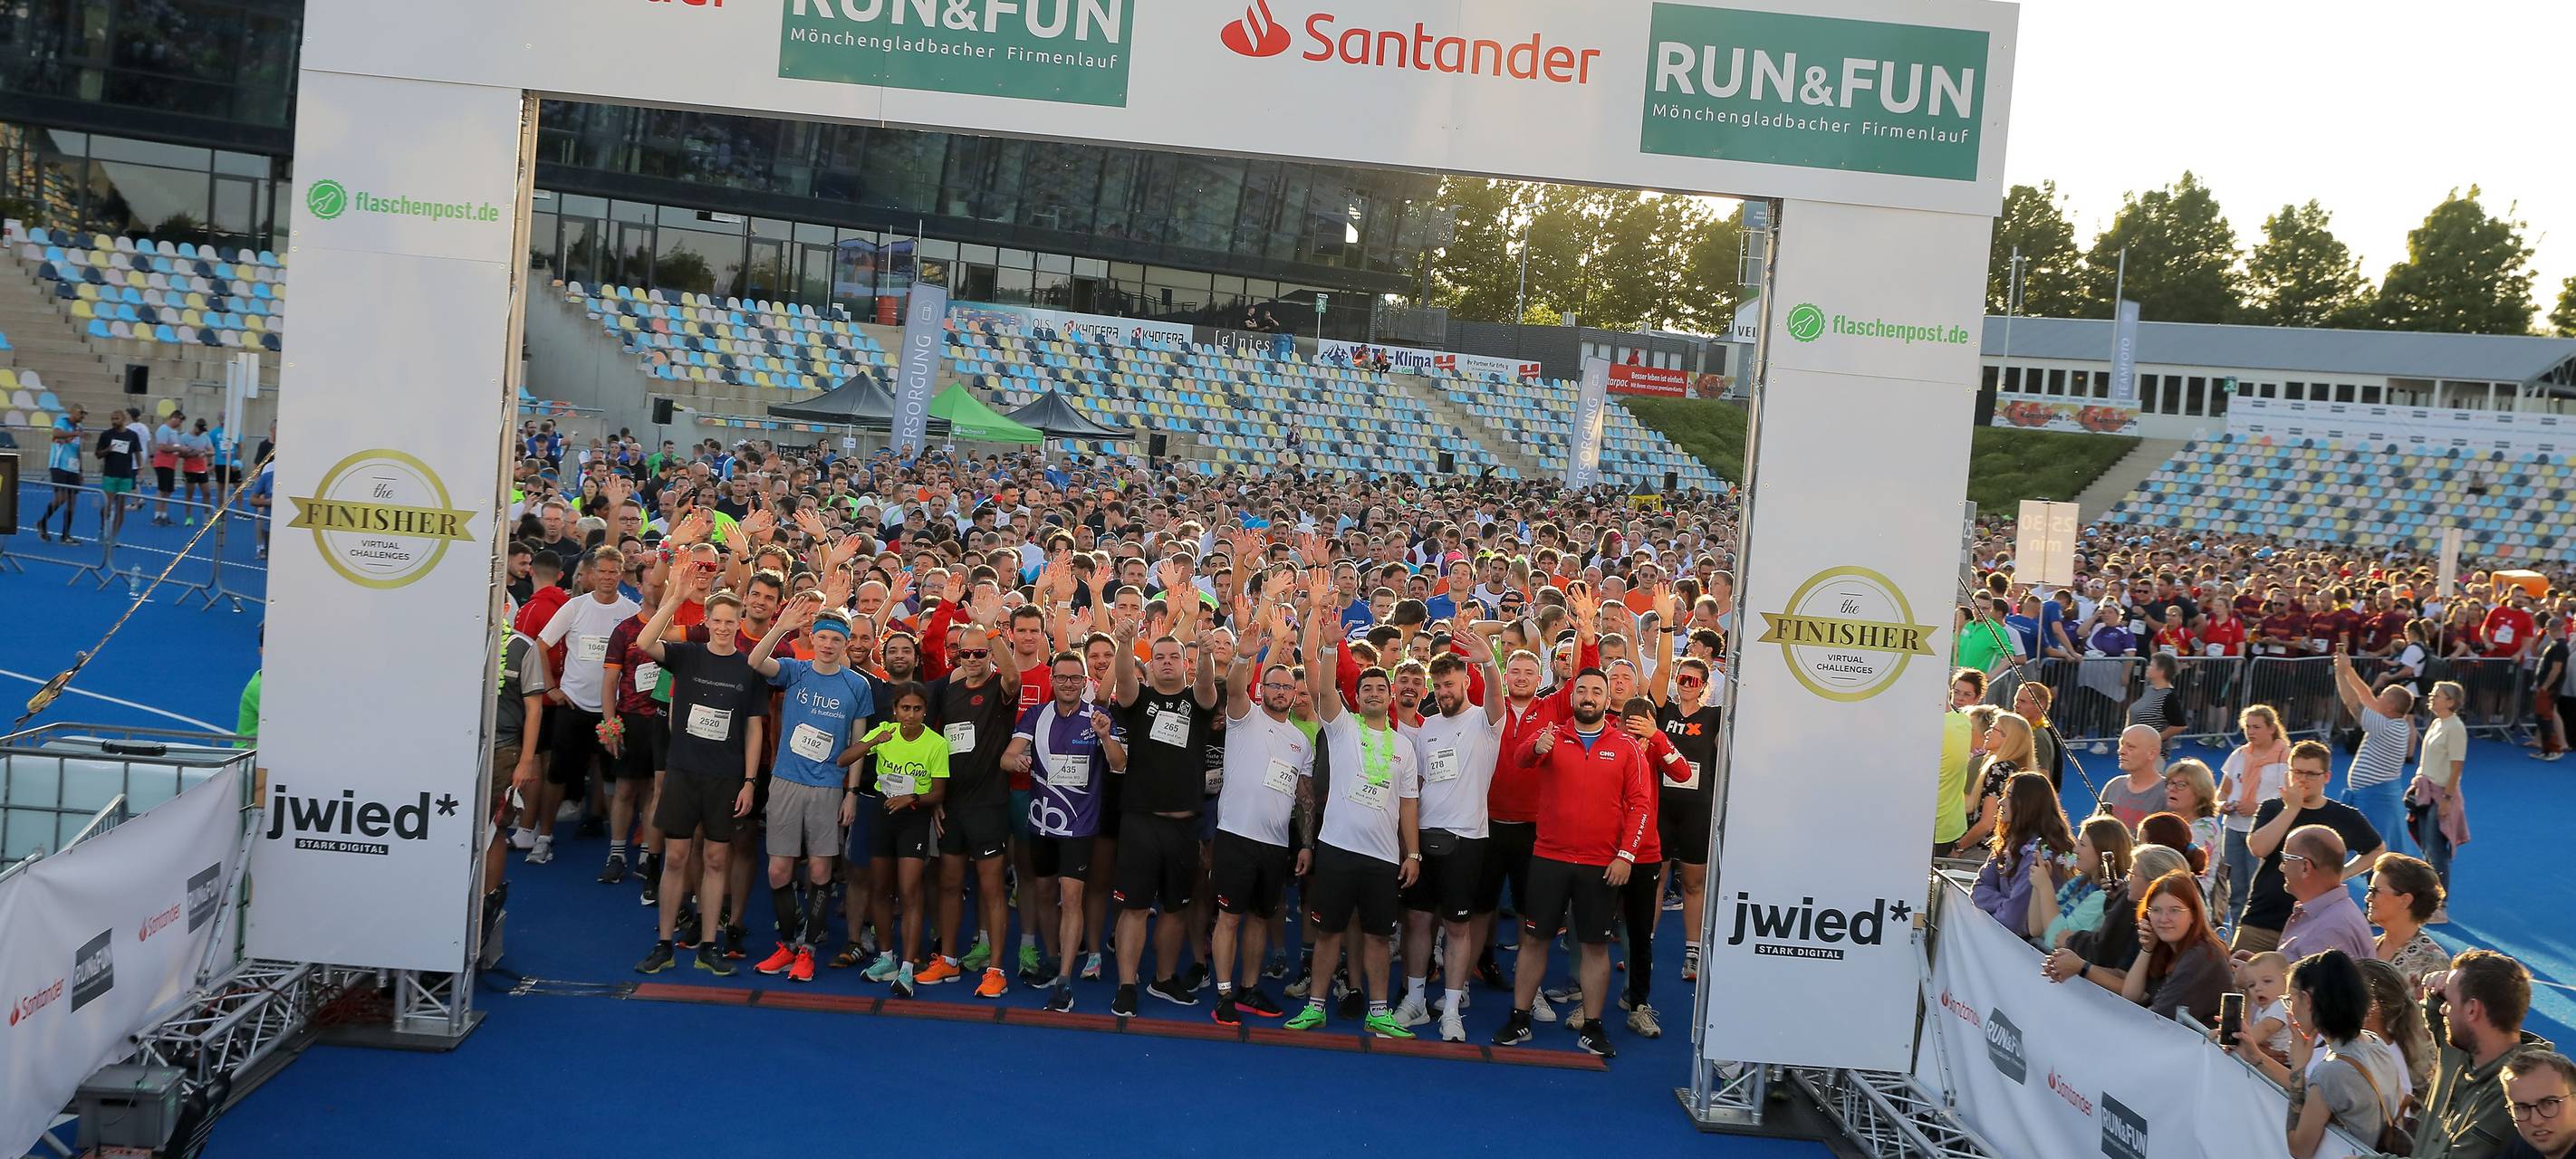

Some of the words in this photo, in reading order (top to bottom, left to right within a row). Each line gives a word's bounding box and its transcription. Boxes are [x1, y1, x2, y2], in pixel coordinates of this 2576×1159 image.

[791, 27, 995, 59] Mönchengladbacher
[1006, 46, 1118, 70] Firmenlauf
[1302, 12, 1600, 84] Santander
[1653, 41, 1975, 119] RUN&FUN
[1651, 103, 1851, 134] Mönchengladbacher
[1861, 120, 1971, 144] Firmenlauf
[355, 191, 499, 222] flaschenpost.de
[1832, 315, 1968, 344] flaschenpost.de
[1631, 371, 1648, 380] Besser
[900, 334, 932, 451] ERSORGUNG
[372, 484, 393, 499] the
[304, 503, 458, 536] FINISHER
[361, 540, 399, 550] VIRTUAL
[350, 549, 410, 560] CHALLENGES
[1840, 599, 1860, 615] the
[1774, 618, 1919, 651] FINISHER
[588, 644, 606, 652] 1048
[1827, 654, 1864, 664] VIRTUAL
[1816, 663, 1873, 675] CHALLENGES
[812, 692, 841, 710] true
[699, 717, 720, 728] 2520
[1164, 722, 1179, 733] 265
[802, 735, 822, 750] 3182
[949, 733, 966, 742] 3517
[1061, 765, 1076, 774] 435
[1430, 760, 1445, 770] 278
[1280, 771, 1293, 782] 279
[1361, 784, 1378, 796] 276
[298, 839, 336, 850] STARK
[339, 842, 385, 854] DIGITAL
[1758, 945, 1794, 956] STARK
[1797, 947, 1841, 959] DIGITAL
[2101, 1106, 2147, 1156] RUN&FUN
